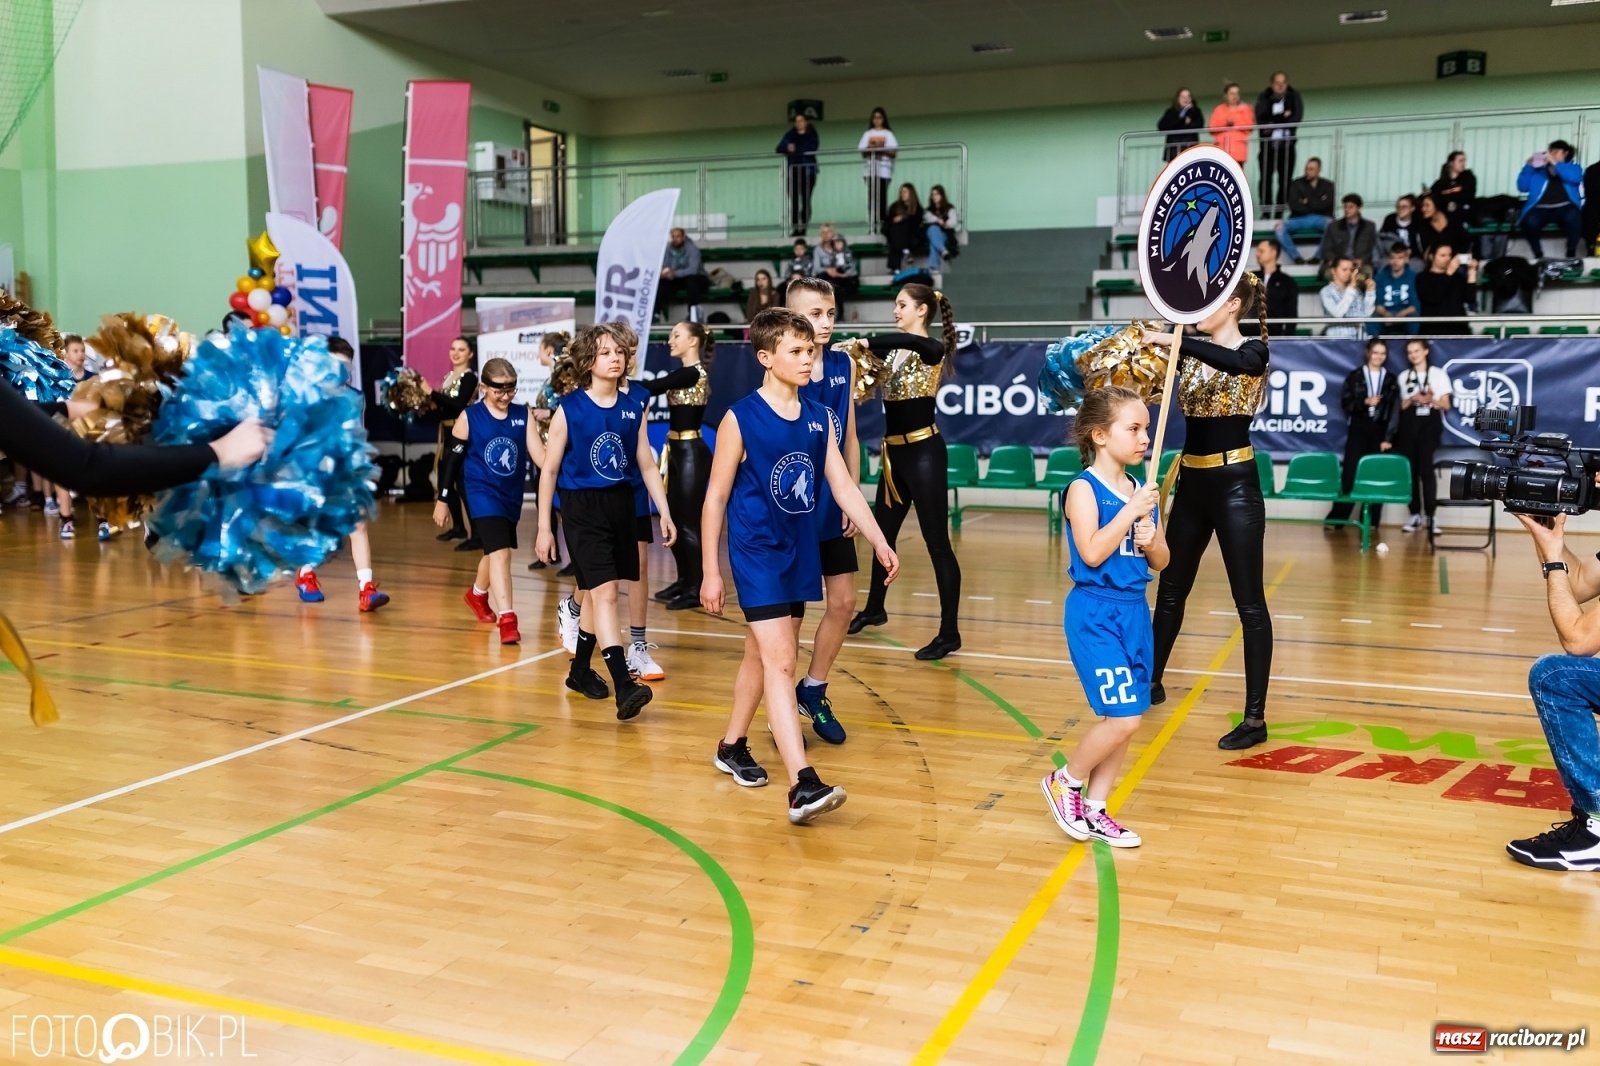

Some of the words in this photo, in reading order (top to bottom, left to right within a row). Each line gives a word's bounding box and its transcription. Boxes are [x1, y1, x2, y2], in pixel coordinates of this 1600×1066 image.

[1443, 60, 1457, 75] B
[1467, 58, 1481, 73] B
[1150, 166, 1203, 258] MINNESOTA
[1209, 166, 1243, 288] TIMBERWOLVES
[1255, 370, 1328, 416] iR
[773, 455, 796, 495] MINNESOTA
[1095, 666, 1137, 705] 22
